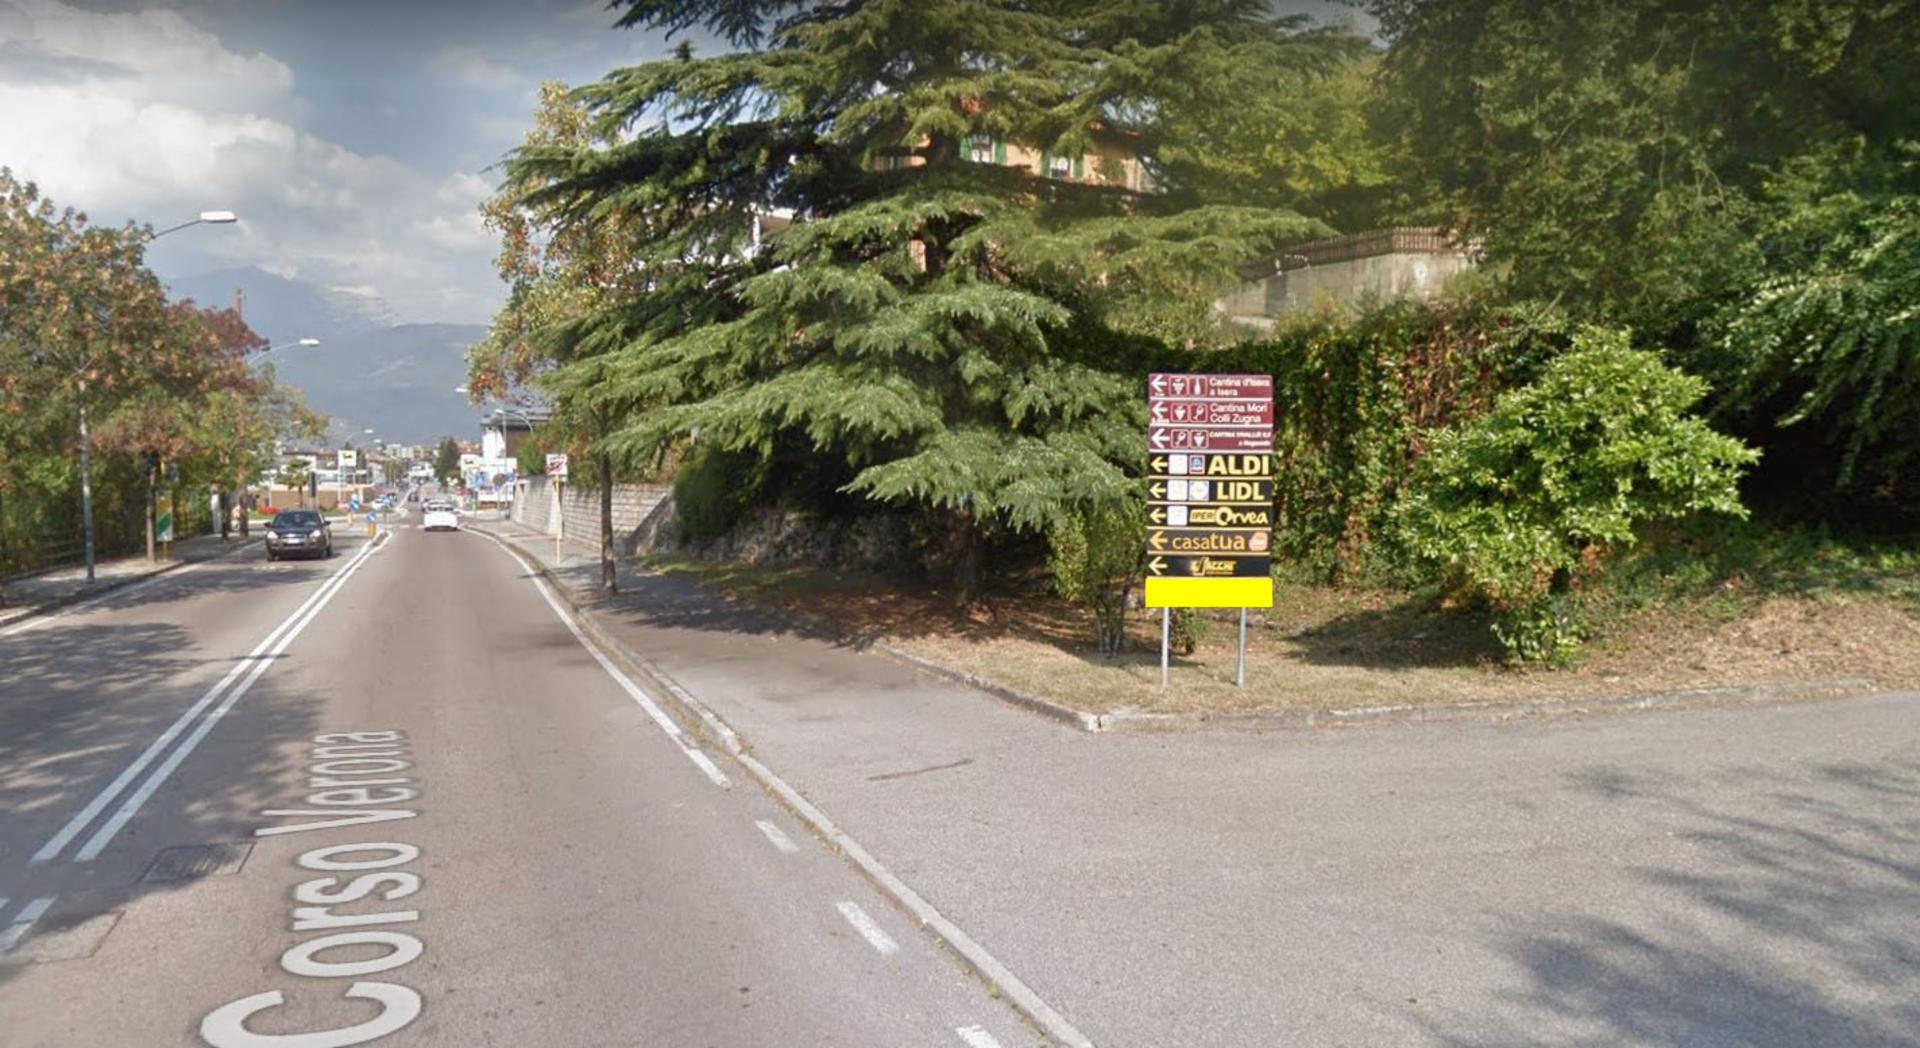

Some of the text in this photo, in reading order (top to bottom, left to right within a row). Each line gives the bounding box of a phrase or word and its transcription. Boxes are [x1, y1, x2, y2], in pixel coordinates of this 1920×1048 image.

[1209, 377, 1241, 387] Cantina
[1210, 403, 1268, 412] Cantina Mori
[1210, 413, 1262, 424] Colli Zugna
[1207, 455, 1269, 475] ALDI
[1217, 482, 1265, 500] LIDL
[1216, 507, 1269, 526] Orvea
[1172, 533, 1245, 550] casatua
